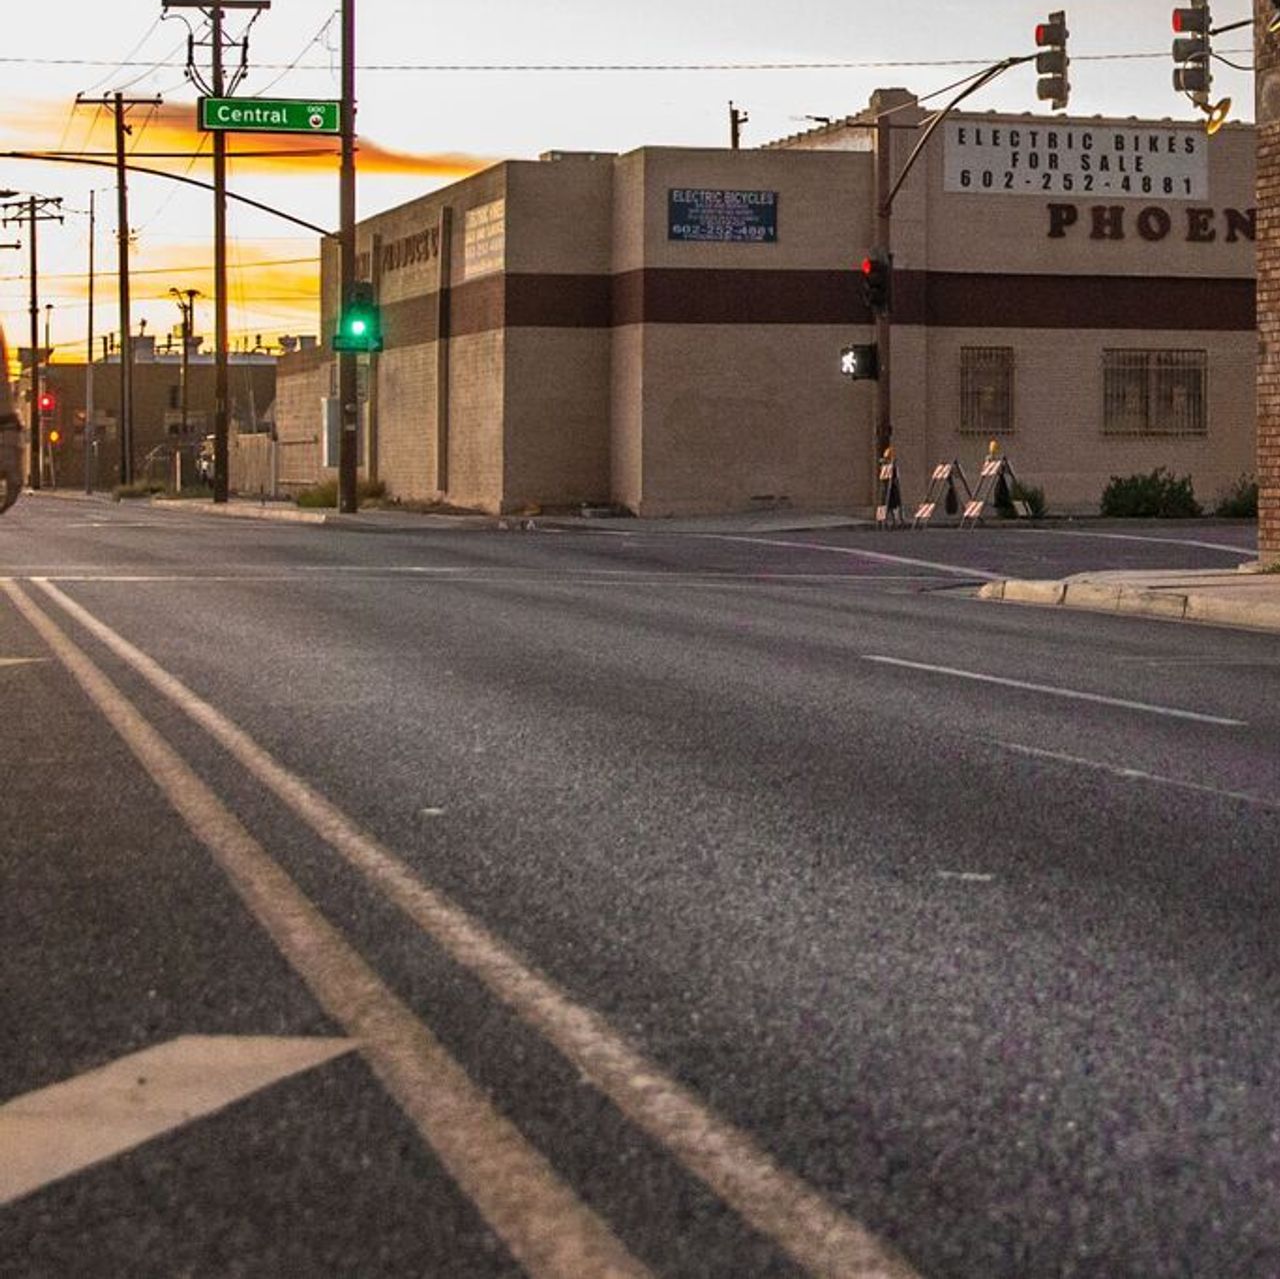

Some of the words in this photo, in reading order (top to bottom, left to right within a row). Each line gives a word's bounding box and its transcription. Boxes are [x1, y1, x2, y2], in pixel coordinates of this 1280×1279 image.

[217, 106, 288, 123] Central
[957, 128, 1093, 150] ELECTRIC
[1114, 132, 1195, 154] BIKES
[1012, 152, 1059, 169] FOR
[1080, 154, 1144, 172] SALE
[960, 170, 1192, 195] 602-252-4881
[673, 190, 722, 203] ELECTRIC
